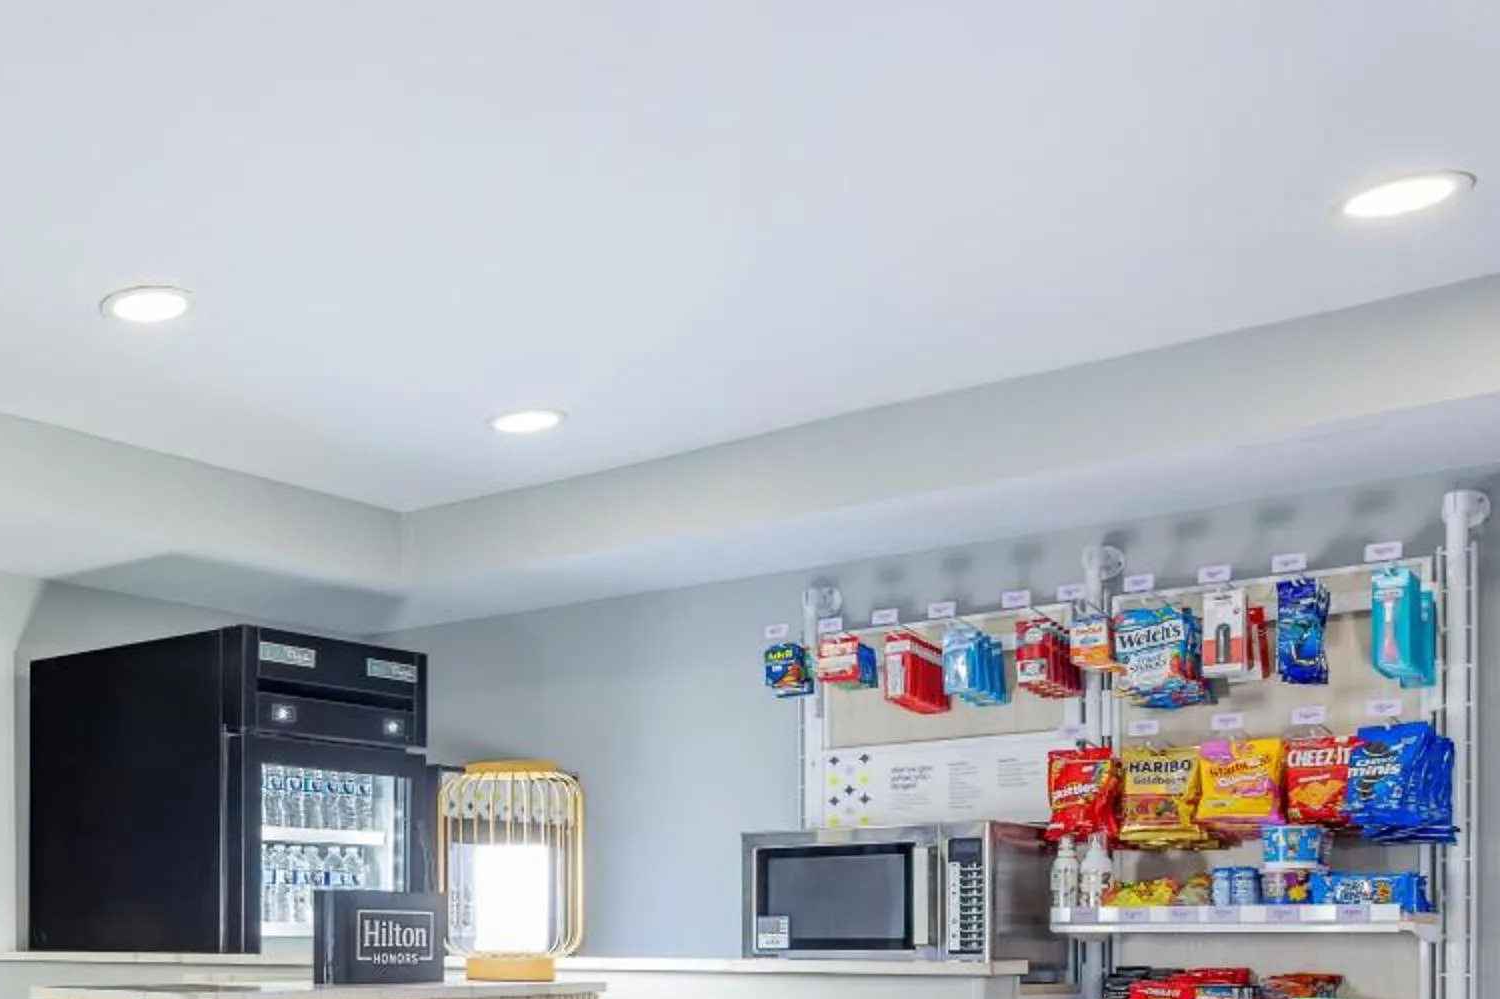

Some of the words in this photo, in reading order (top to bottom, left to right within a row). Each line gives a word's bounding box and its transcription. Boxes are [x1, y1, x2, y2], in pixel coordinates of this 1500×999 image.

[1117, 622, 1182, 650] Welch's
[1129, 759, 1192, 773] HARIBO
[363, 919, 429, 948] Hilton
[372, 952, 419, 965] HONORS
